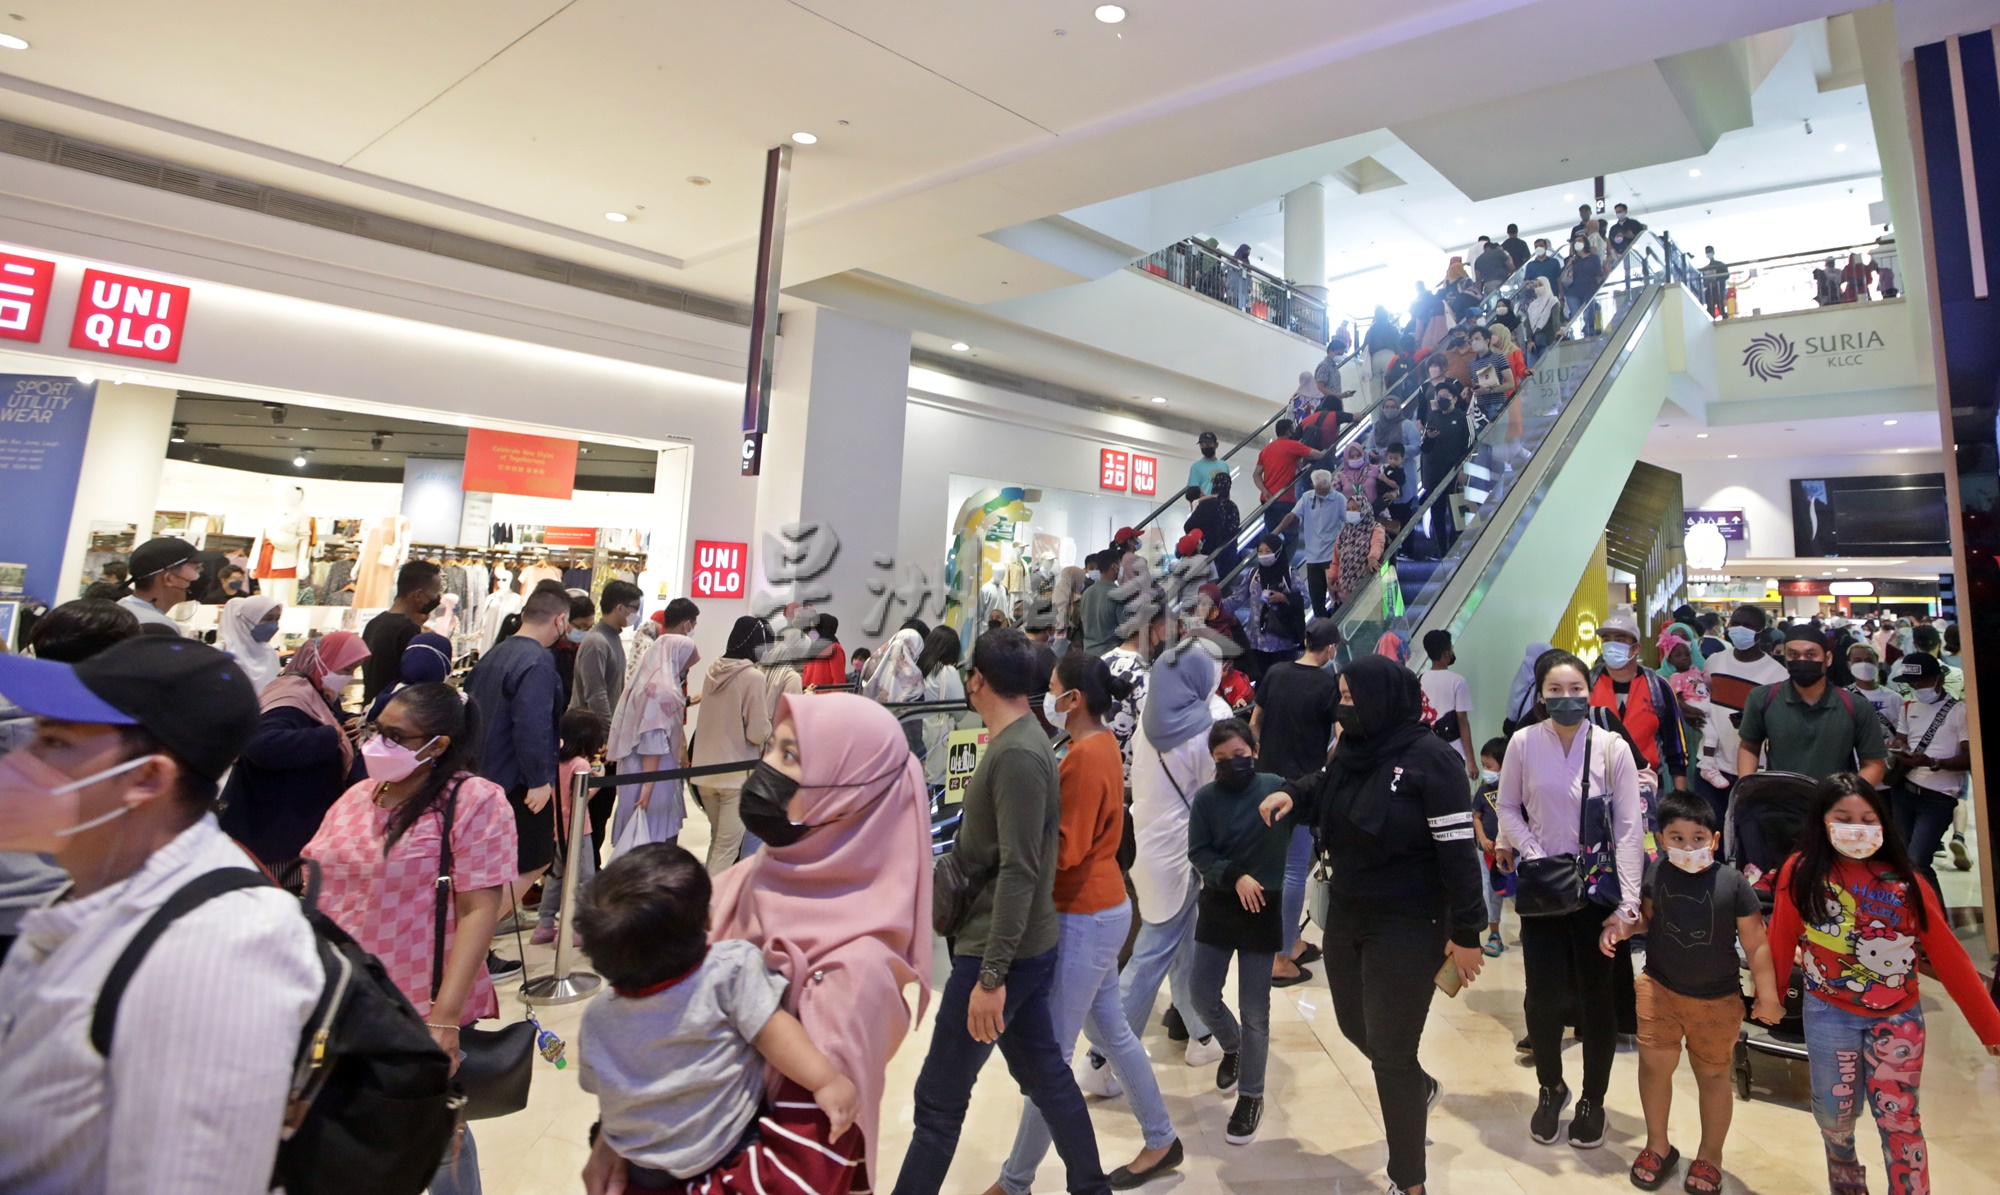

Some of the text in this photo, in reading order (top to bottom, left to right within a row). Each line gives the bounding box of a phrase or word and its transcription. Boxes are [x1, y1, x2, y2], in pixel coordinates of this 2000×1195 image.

[92, 280, 171, 320] UNI
[85, 313, 171, 351] QLO
[1805, 331, 1885, 354] SURIA
[1828, 354, 1863, 367] KLCC
[14, 380, 74, 395] SPORT
[7, 394, 73, 410] UTILITY
[0, 408, 53, 423] WEAR
[742, 439, 755, 459] C
[1134, 458, 1154, 476] UNI
[1134, 474, 1155, 491] QLO
[700, 547, 739, 570] UNI
[698, 571, 740, 595] QLO
[1851, 882, 1903, 908] Hello
[1860, 900, 1903, 927] Kitty
